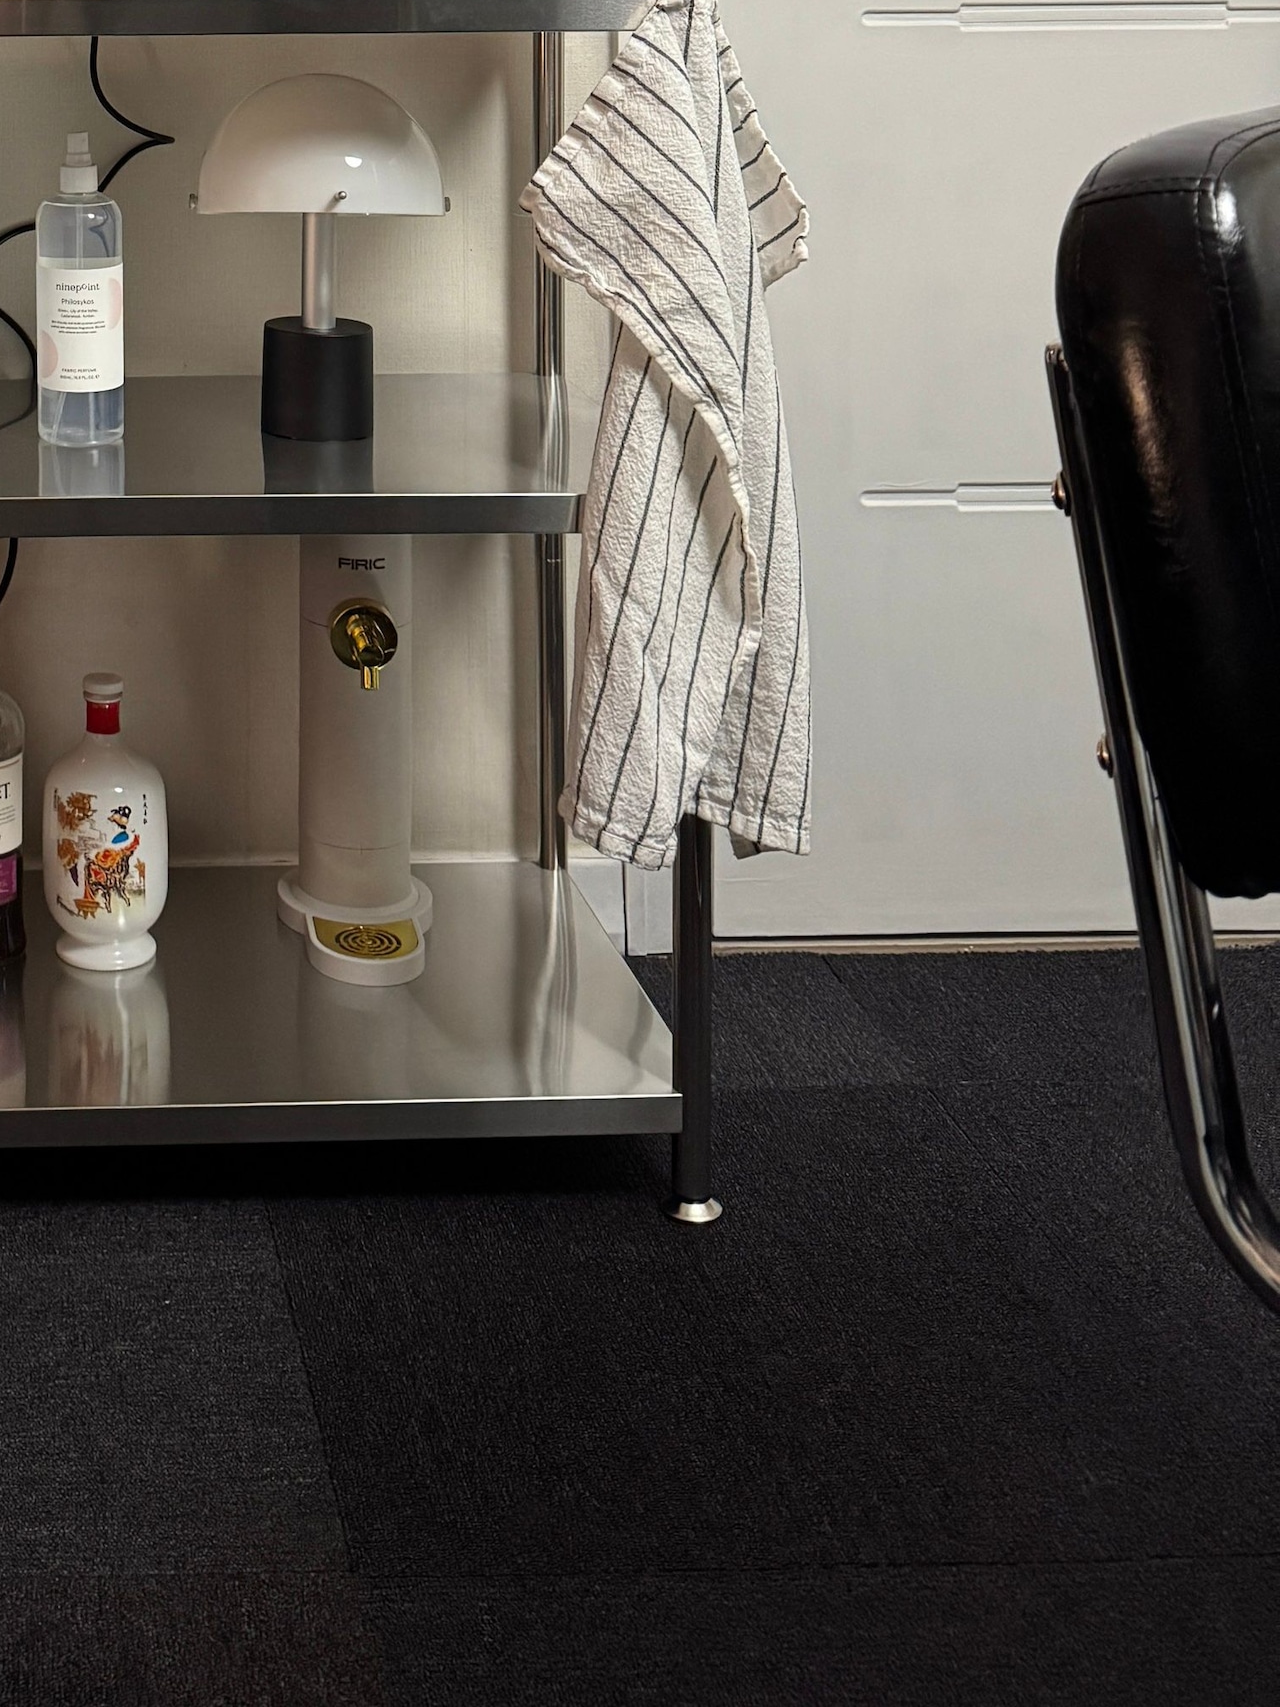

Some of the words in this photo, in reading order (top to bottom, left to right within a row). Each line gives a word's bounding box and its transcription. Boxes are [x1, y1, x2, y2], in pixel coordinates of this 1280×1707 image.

[55, 281, 100, 293] ninepoint
[61, 297, 95, 305] Philosykos
[338, 557, 386, 570] FIRIC
